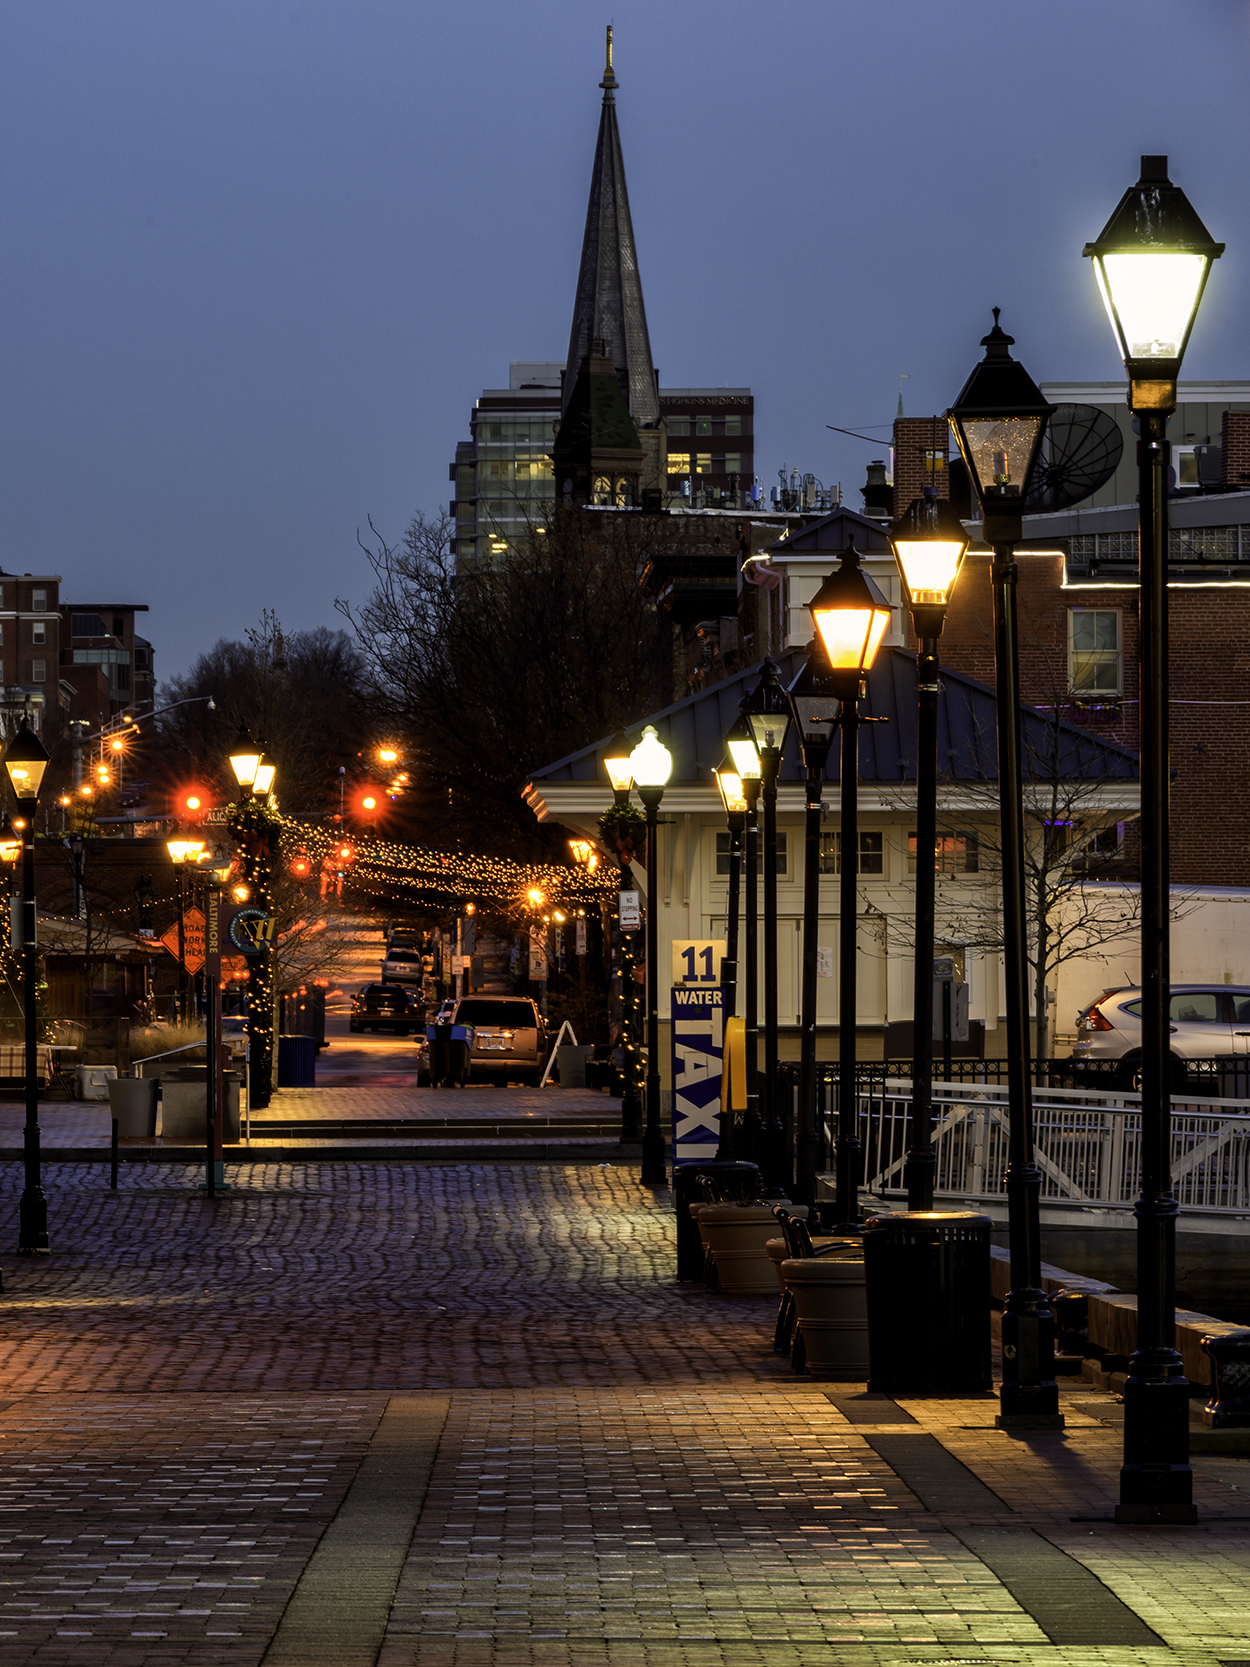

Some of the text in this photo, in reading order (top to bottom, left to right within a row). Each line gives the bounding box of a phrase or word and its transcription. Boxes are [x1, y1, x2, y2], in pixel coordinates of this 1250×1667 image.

[706, 397, 749, 405] MEDICINE
[207, 812, 225, 821] ALIC
[209, 893, 218, 954] BALTIMORE
[681, 946, 716, 982] 11
[675, 990, 723, 1005] WATER
[675, 1007, 723, 1159] TAXI
